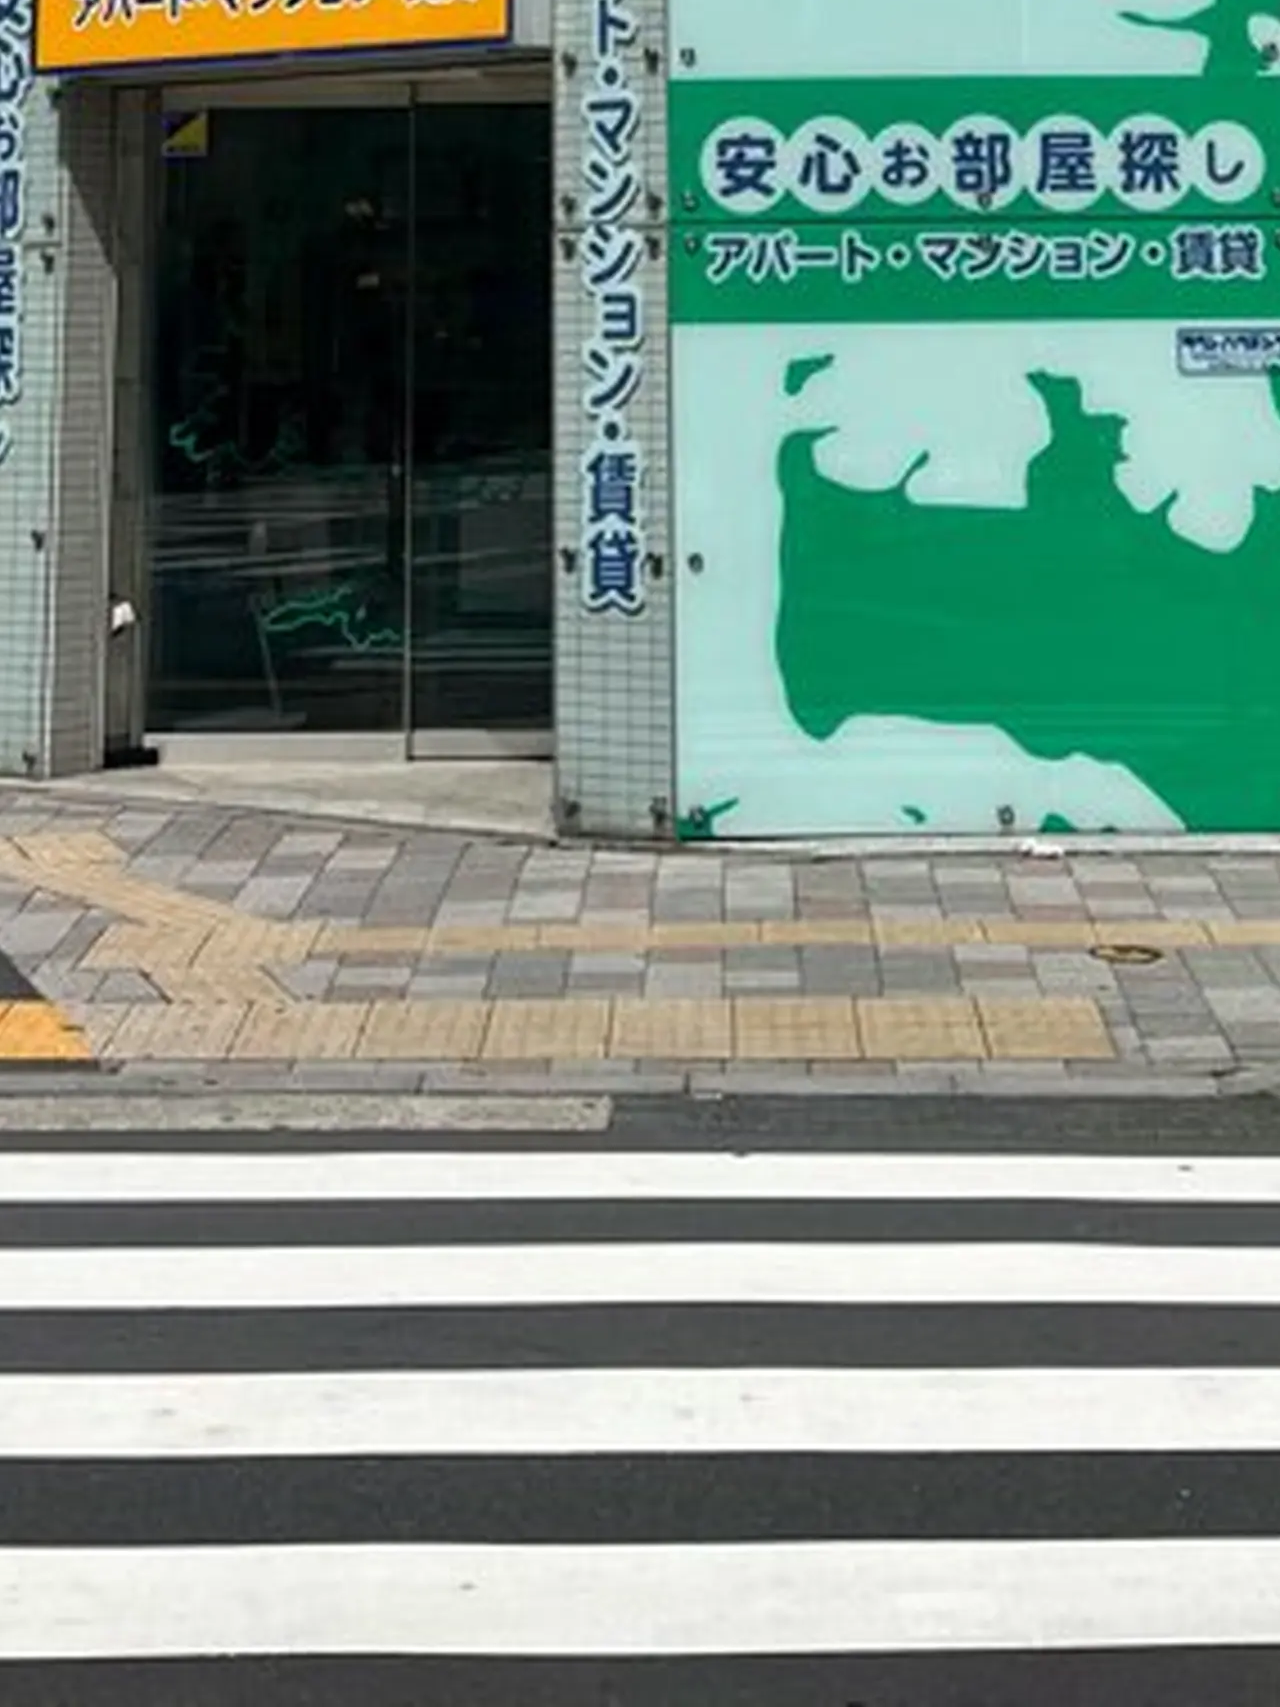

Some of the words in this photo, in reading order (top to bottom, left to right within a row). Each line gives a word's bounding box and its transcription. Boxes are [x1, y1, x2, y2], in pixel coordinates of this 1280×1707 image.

[715, 131, 1246, 198] 安心お部屋探し
[708, 229, 1263, 280] アパート・マンション・賃貸
